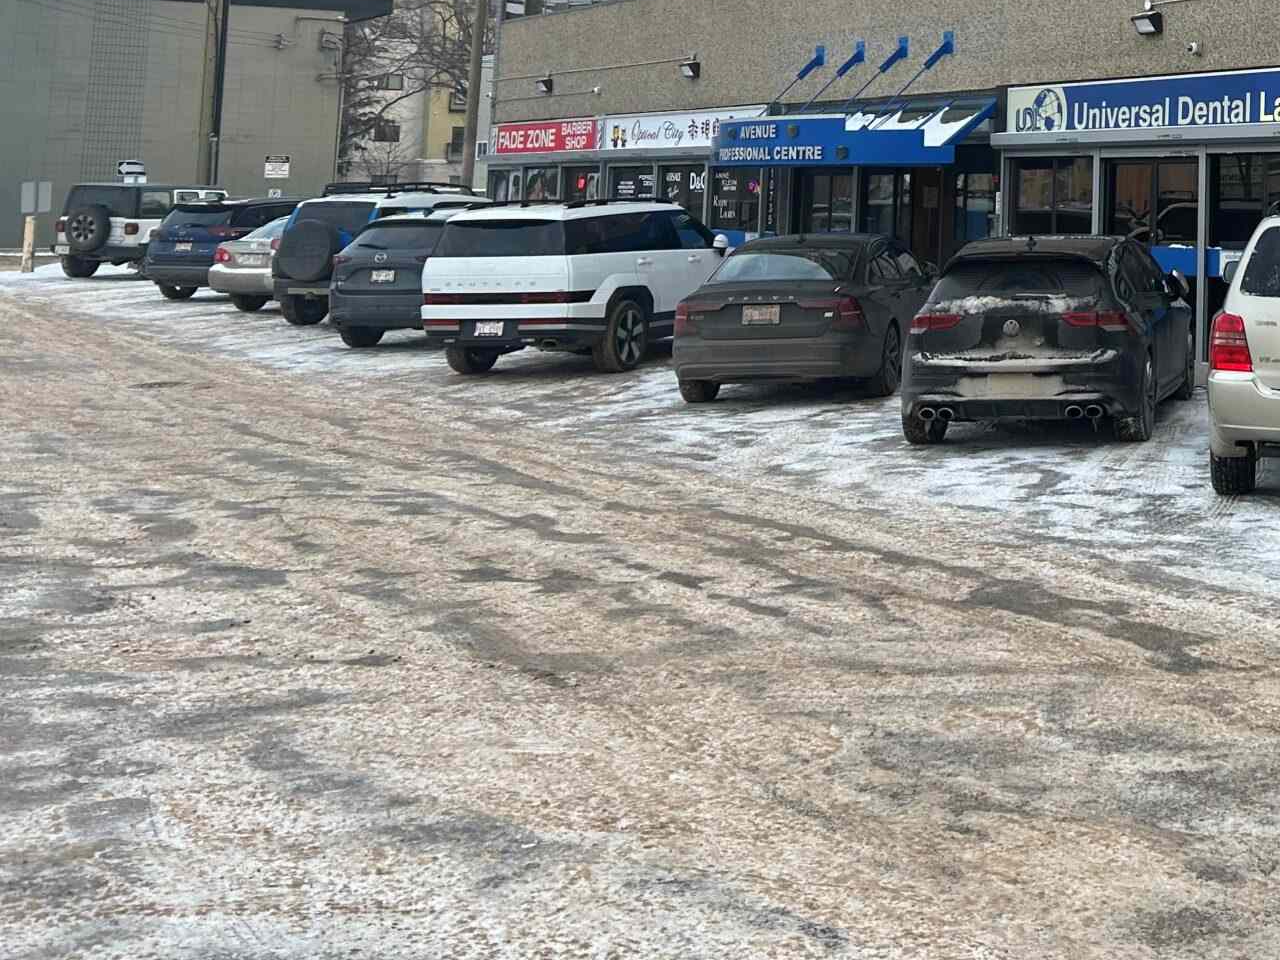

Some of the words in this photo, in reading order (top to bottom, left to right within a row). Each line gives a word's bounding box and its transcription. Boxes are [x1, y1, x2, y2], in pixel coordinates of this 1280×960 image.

[1073, 97, 1169, 130] Universal
[1177, 92, 1251, 124] Dental
[561, 121, 592, 135] BARBER
[663, 120, 684, 146] City
[740, 124, 777, 139] AVENUE
[497, 131, 525, 149] FADE
[526, 128, 556, 148] ZONE
[565, 136, 587, 149] SHOP
[719, 146, 771, 161] PROFESSIONAL
[773, 145, 823, 160] CENTRE
